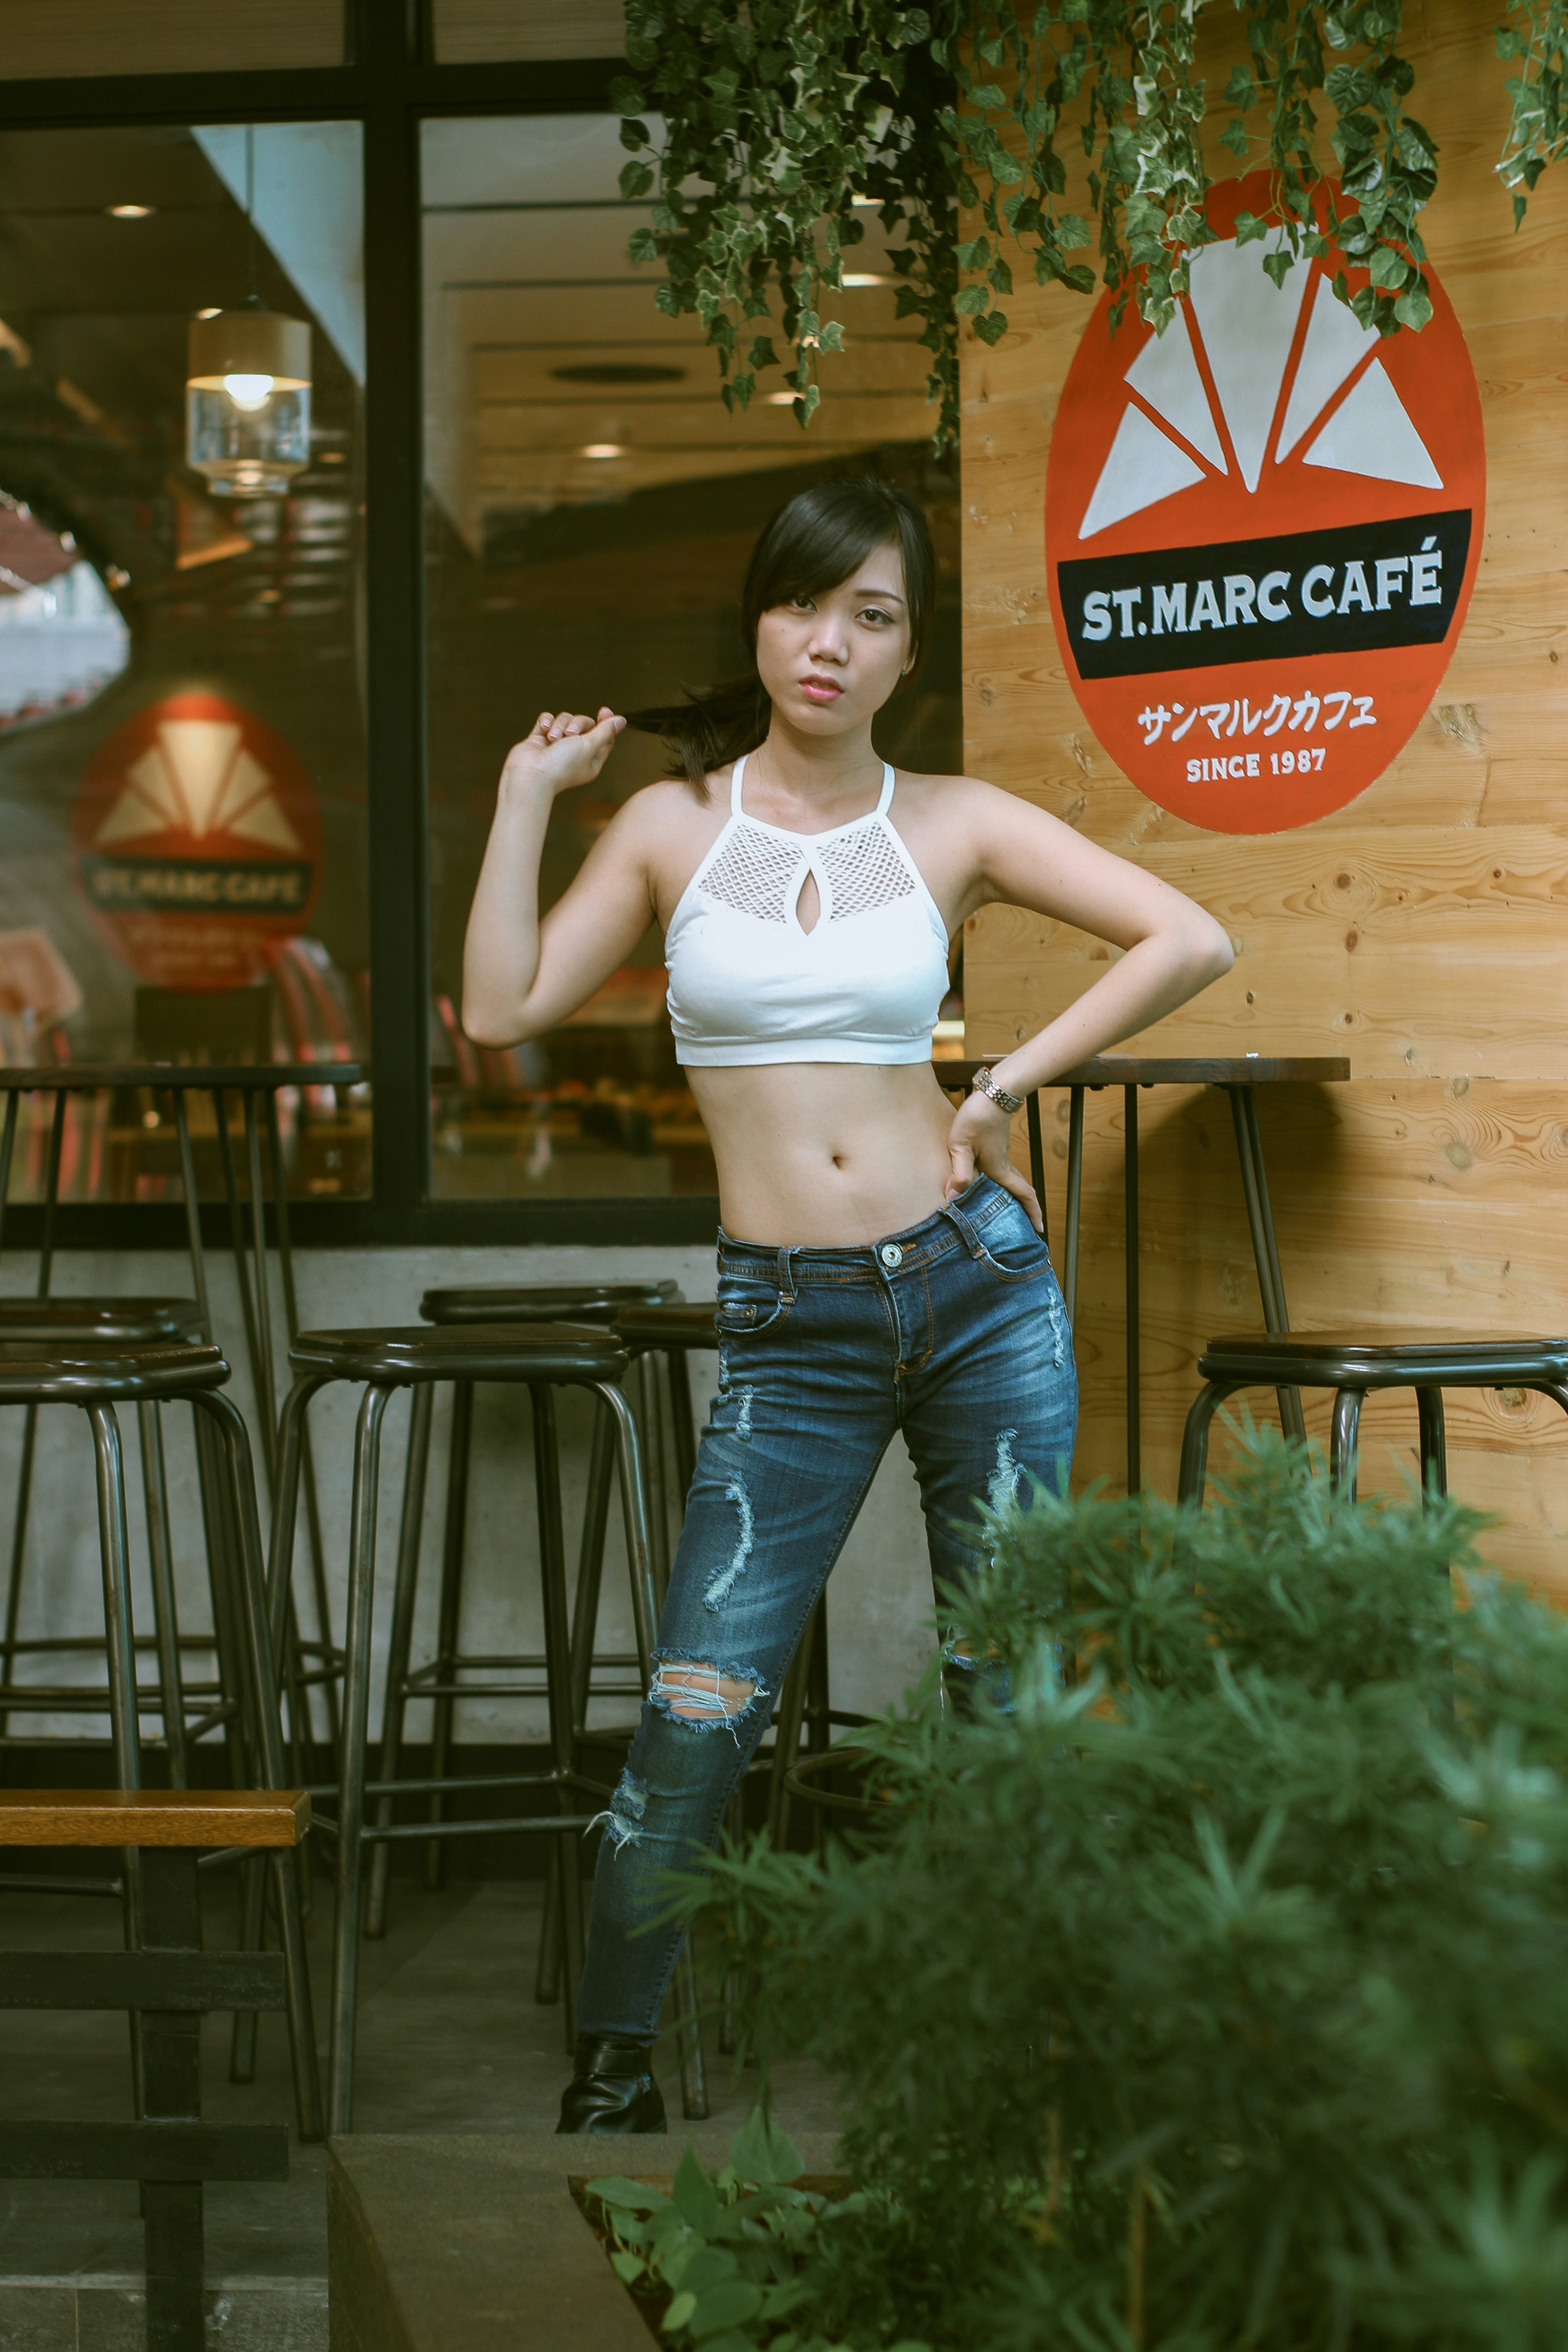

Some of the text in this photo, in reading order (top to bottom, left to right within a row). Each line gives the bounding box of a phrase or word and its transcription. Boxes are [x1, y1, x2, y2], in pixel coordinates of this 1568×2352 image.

[1301, 536, 1443, 617] CAFÉ
[1186, 747, 1326, 783] SINCE 1987
